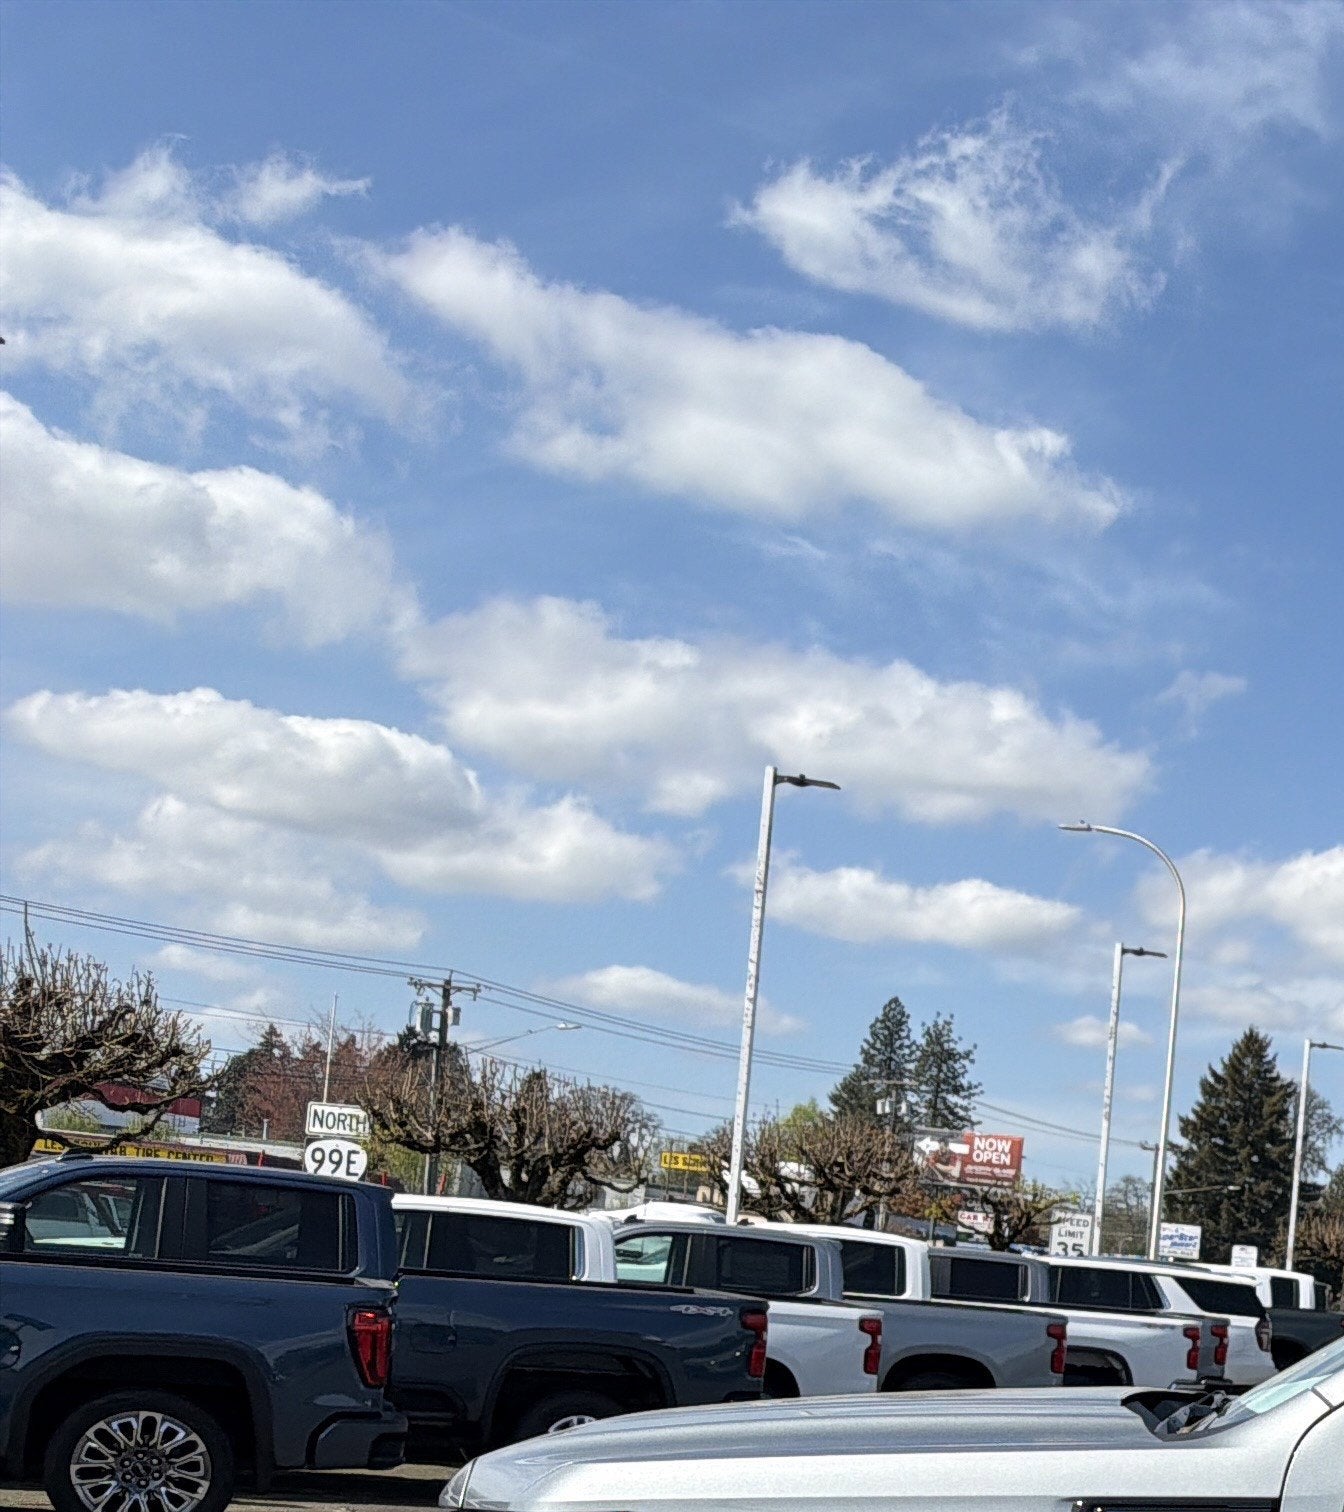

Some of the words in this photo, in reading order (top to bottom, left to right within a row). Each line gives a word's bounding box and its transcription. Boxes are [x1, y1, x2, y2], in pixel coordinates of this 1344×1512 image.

[312, 1109, 367, 1132] NORTH
[974, 1136, 1012, 1153] NOW
[311, 1147, 361, 1177] 99E
[972, 1149, 1011, 1165] OPEN
[1057, 1216, 1089, 1228] PEED
[1057, 1227, 1085, 1240] LIMIT
[1055, 1241, 1084, 1257] 35
